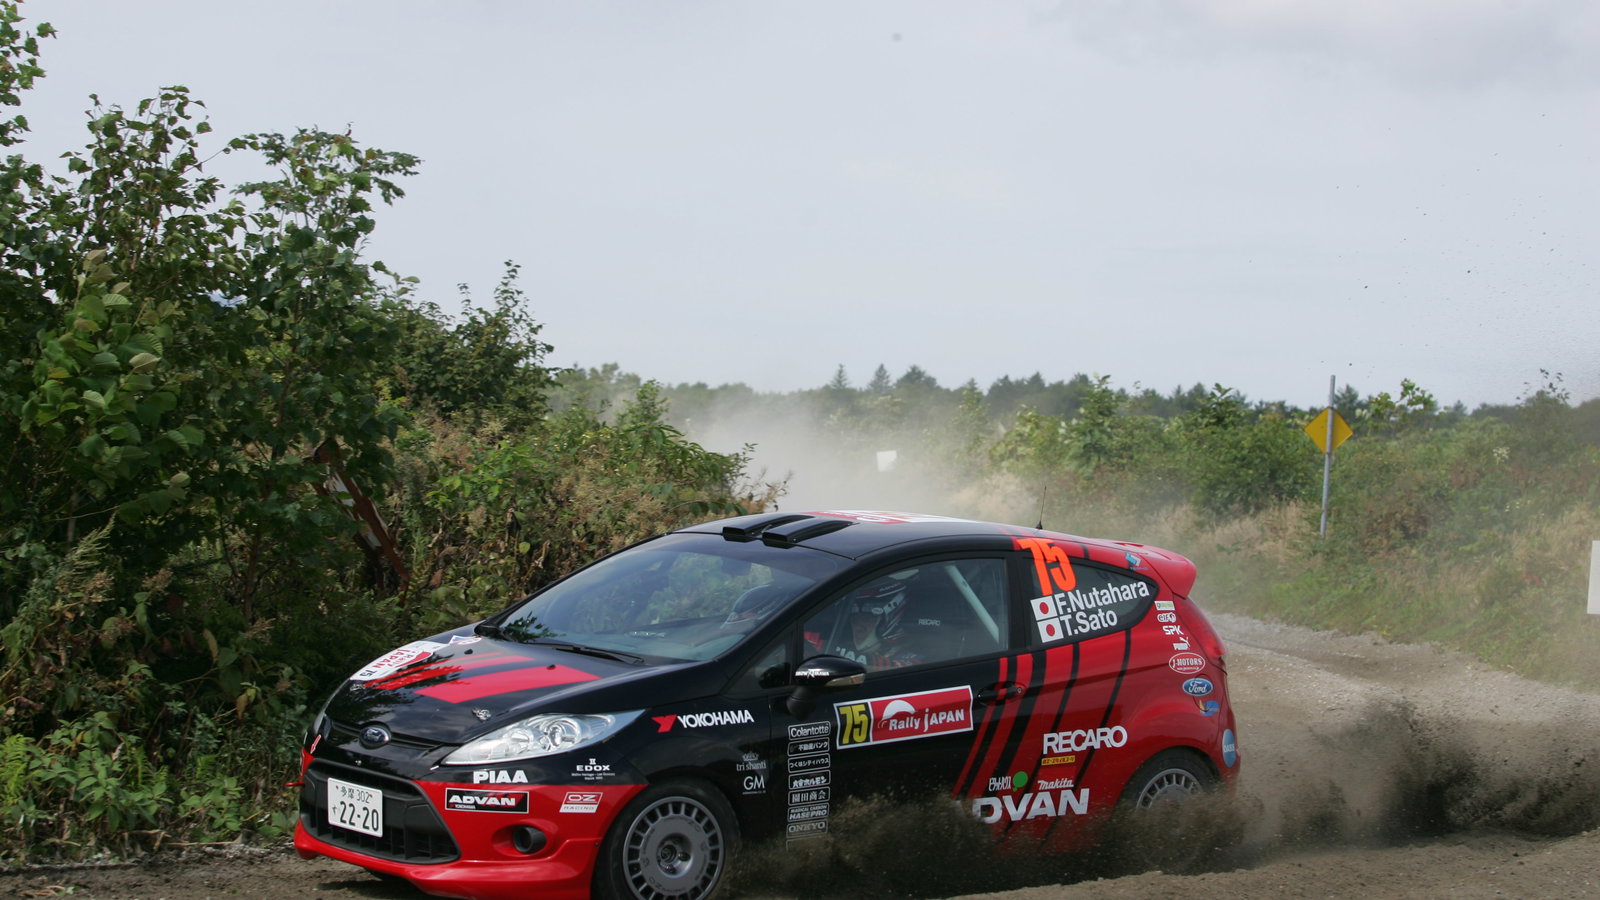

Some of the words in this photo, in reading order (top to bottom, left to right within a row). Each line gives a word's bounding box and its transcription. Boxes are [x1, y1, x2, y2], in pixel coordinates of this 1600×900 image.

[1017, 538, 1077, 596] 75
[1054, 580, 1150, 615] F.Nutahara
[1060, 607, 1118, 637] T.Sato
[1187, 679, 1208, 694] Ford
[677, 709, 755, 729] YOKOHAMA
[838, 703, 869, 745] 75
[888, 717, 921, 731] Rally
[1043, 725, 1128, 755] RECARO
[473, 769, 529, 785] PIAA
[576, 764, 612, 773] EDOX
[743, 774, 766, 791] GM
[356, 788, 371, 804] 302
[448, 794, 516, 806] ADVAN
